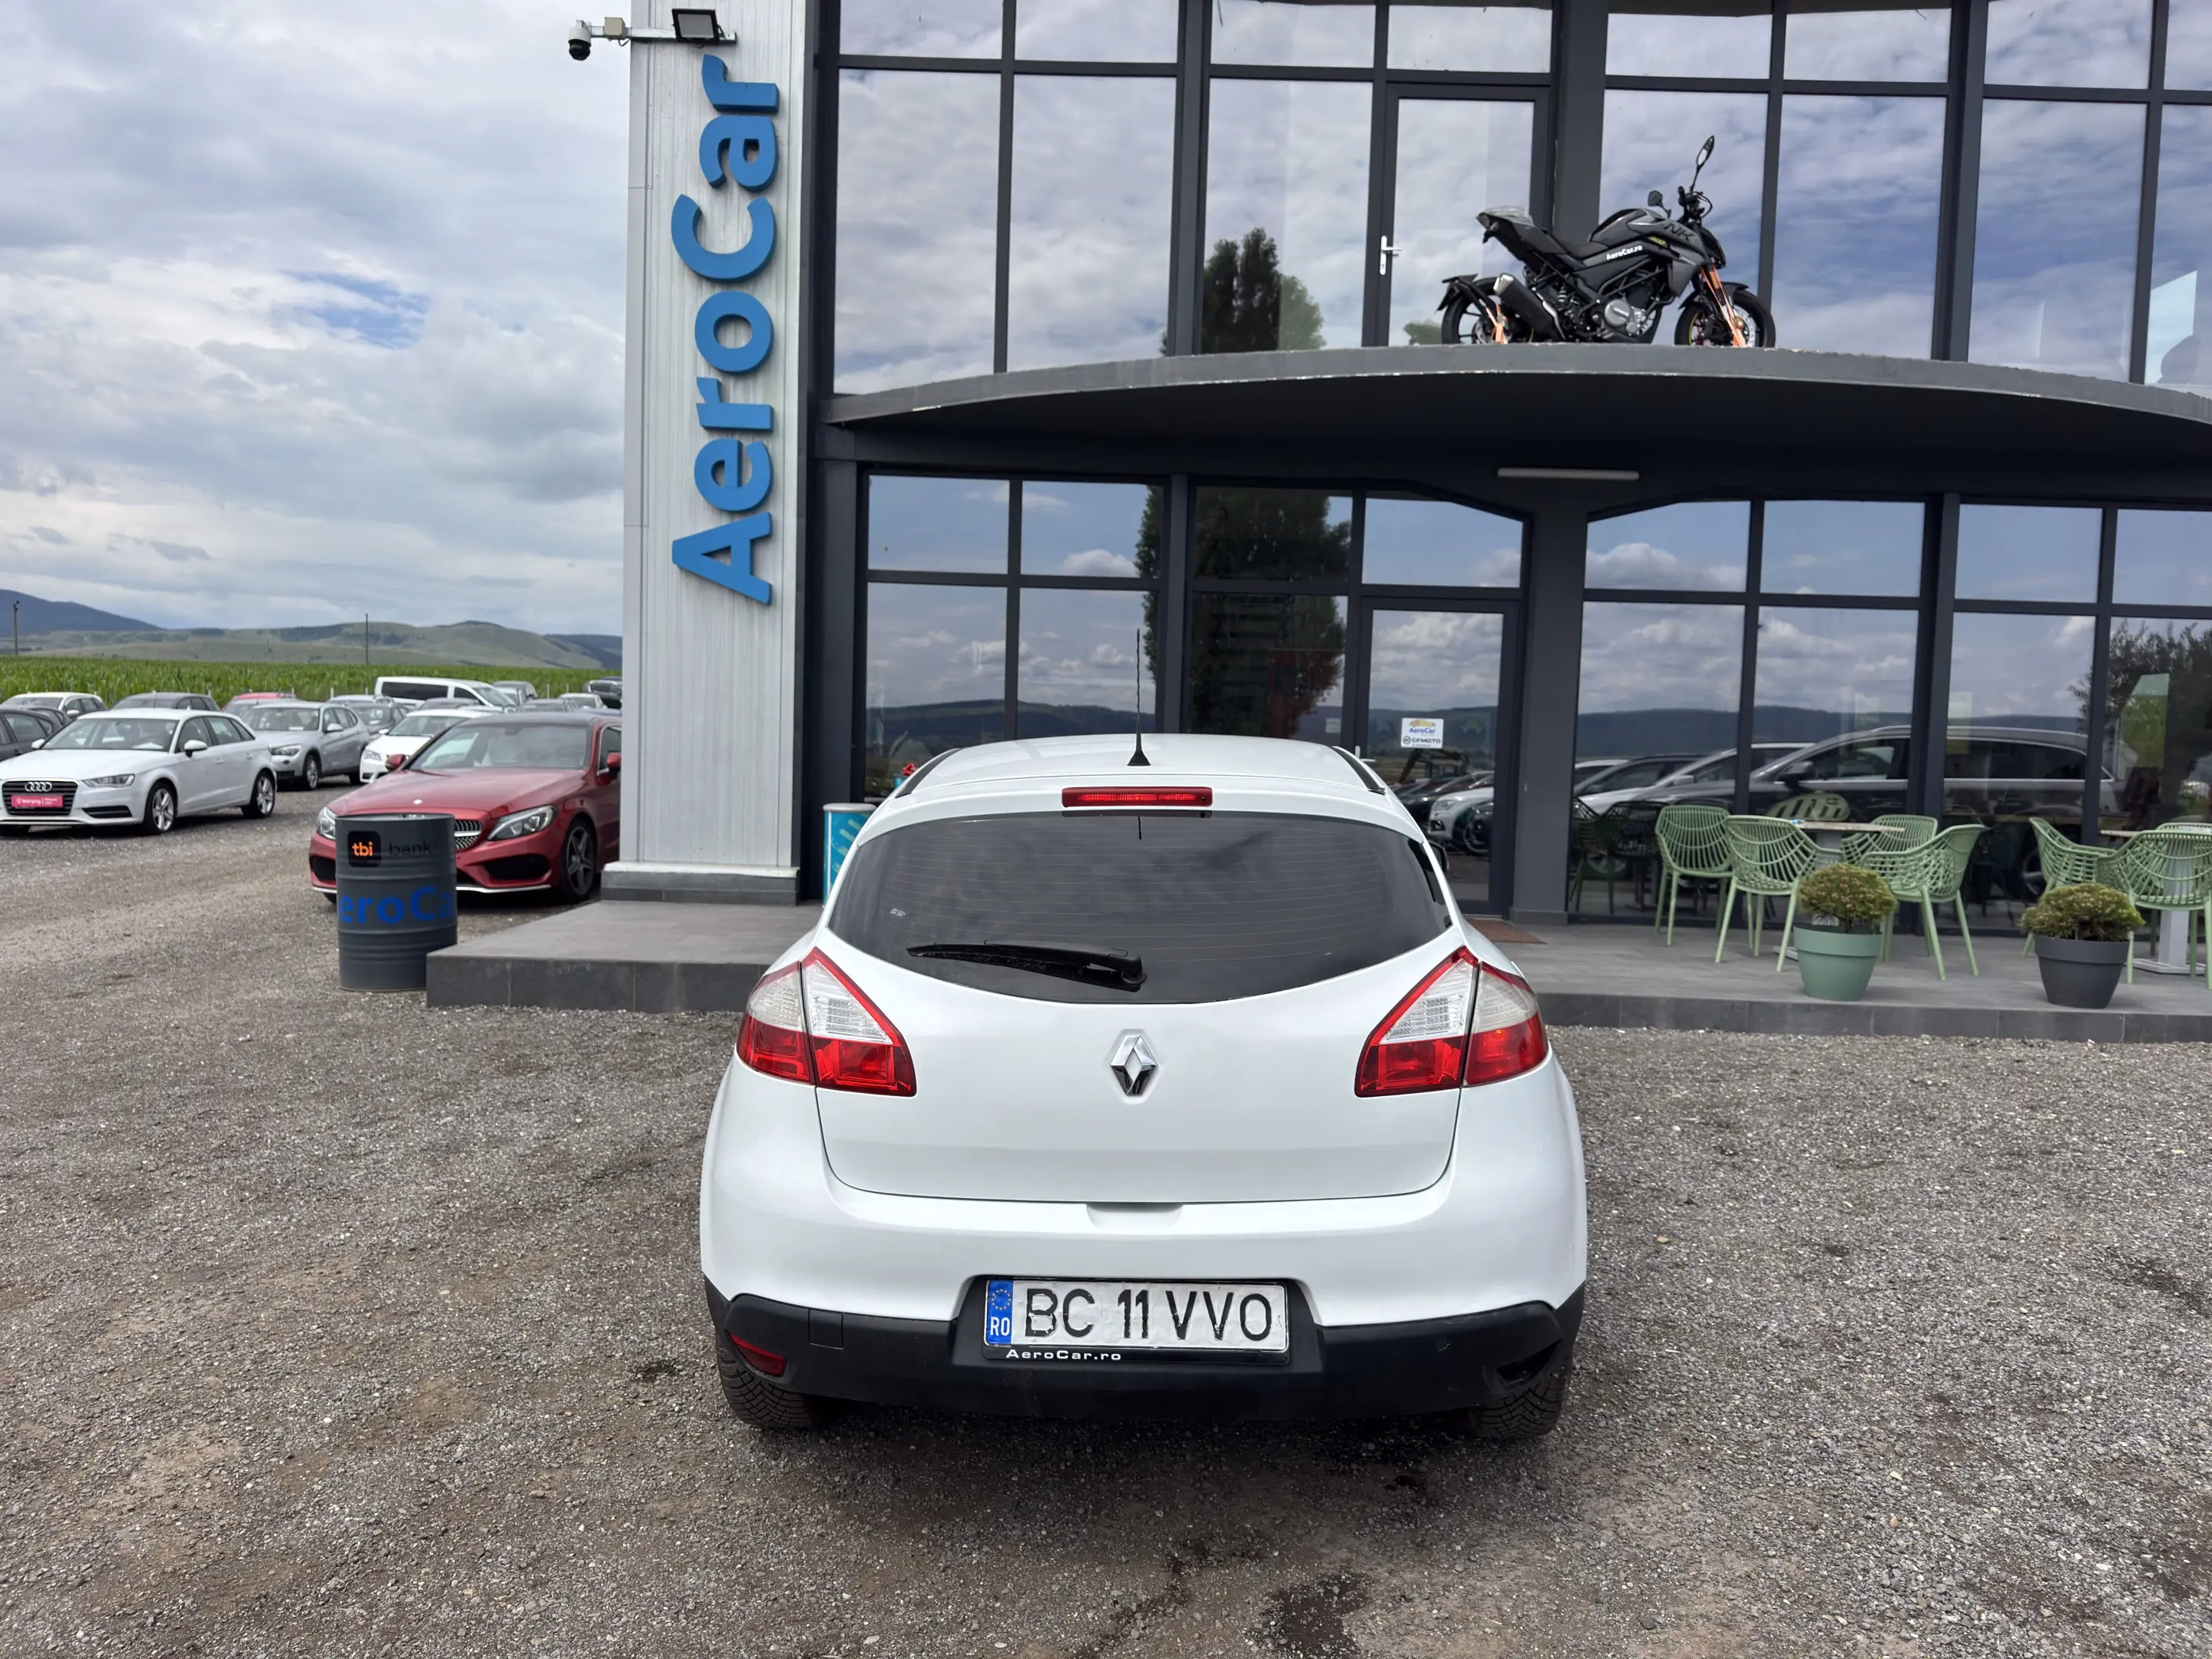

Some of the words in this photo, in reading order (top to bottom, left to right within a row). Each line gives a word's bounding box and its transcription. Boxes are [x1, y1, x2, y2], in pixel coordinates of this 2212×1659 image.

[1606, 245, 1643, 260] AeroCar.ro
[671, 54, 780, 605] AeroCar
[352, 841, 374, 857] tbi
[389, 840, 432, 856] bank
[1025, 1288, 1096, 1338] BC
[1117, 1288, 1150, 1339] 11
[1165, 1290, 1273, 1342] VVO
[990, 1316, 1011, 1337] RO
[1005, 1349, 1122, 1362] AeroCar.ro
